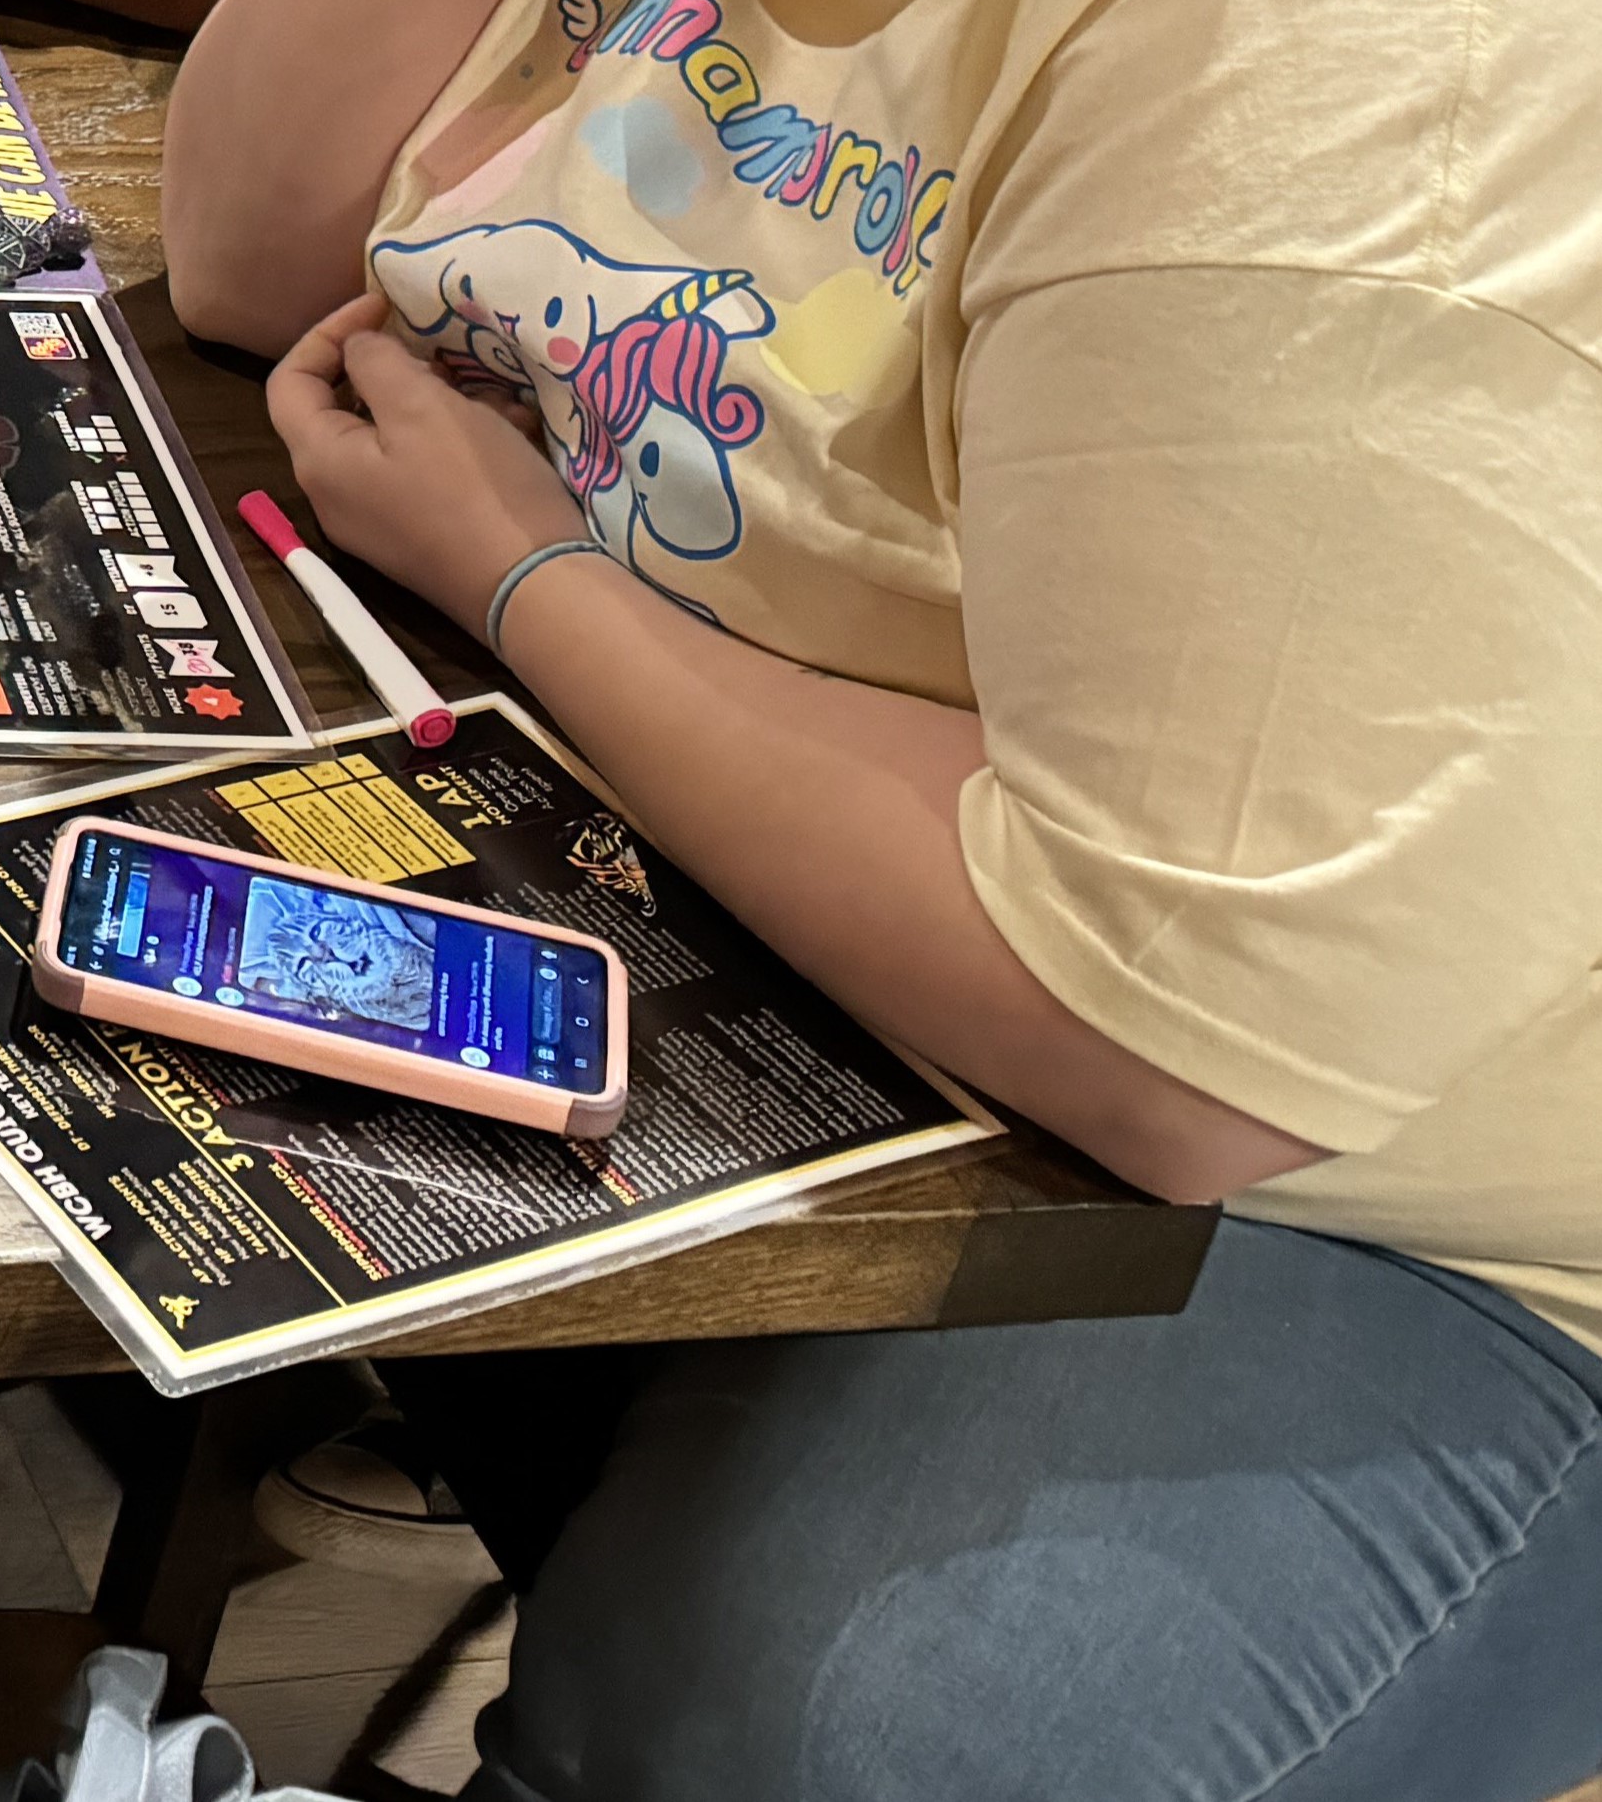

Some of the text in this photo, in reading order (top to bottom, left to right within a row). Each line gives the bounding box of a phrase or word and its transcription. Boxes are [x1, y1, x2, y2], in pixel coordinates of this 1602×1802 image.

[63, 435, 82, 450] LIFE
[158, 602, 179, 615] 15
[136, 633, 161, 662] POINTS
[177, 642, 198, 655] 38
[201, 697, 221, 705] 4
[436, 764, 514, 825] MOVEMENT
[462, 766, 522, 812] One zone
[484, 767, 533, 803] per one
[486, 756, 557, 810] Action Point
[519, 766, 556, 792] spent
[409, 770, 494, 829] 1 AP
[4, 879, 30, 898] FOR
[25, 1023, 97, 1097] HERO'S FAVOR
[3, 1088, 41, 1119] KEY
[15, 1073, 73, 1130] DEFENSIVE
[115, 1039, 237, 1151] ACTION
[70, 1136, 92, 1151] DT
[190, 1157, 222, 1183] check
[218, 1151, 259, 1173] 3
[31, 1163, 116, 1240] WCBH
[176, 1160, 270, 1254] TALENT MODIFIER
[215, 1184, 248, 1211] Talent
[106, 1174, 213, 1285] AP ACTION POINTS
[150, 1177, 236, 1264] HP HIT POINTS
[195, 1205, 234, 1239] healthy
[266, 1161, 385, 1281] SUPERPOWER ATTACK
